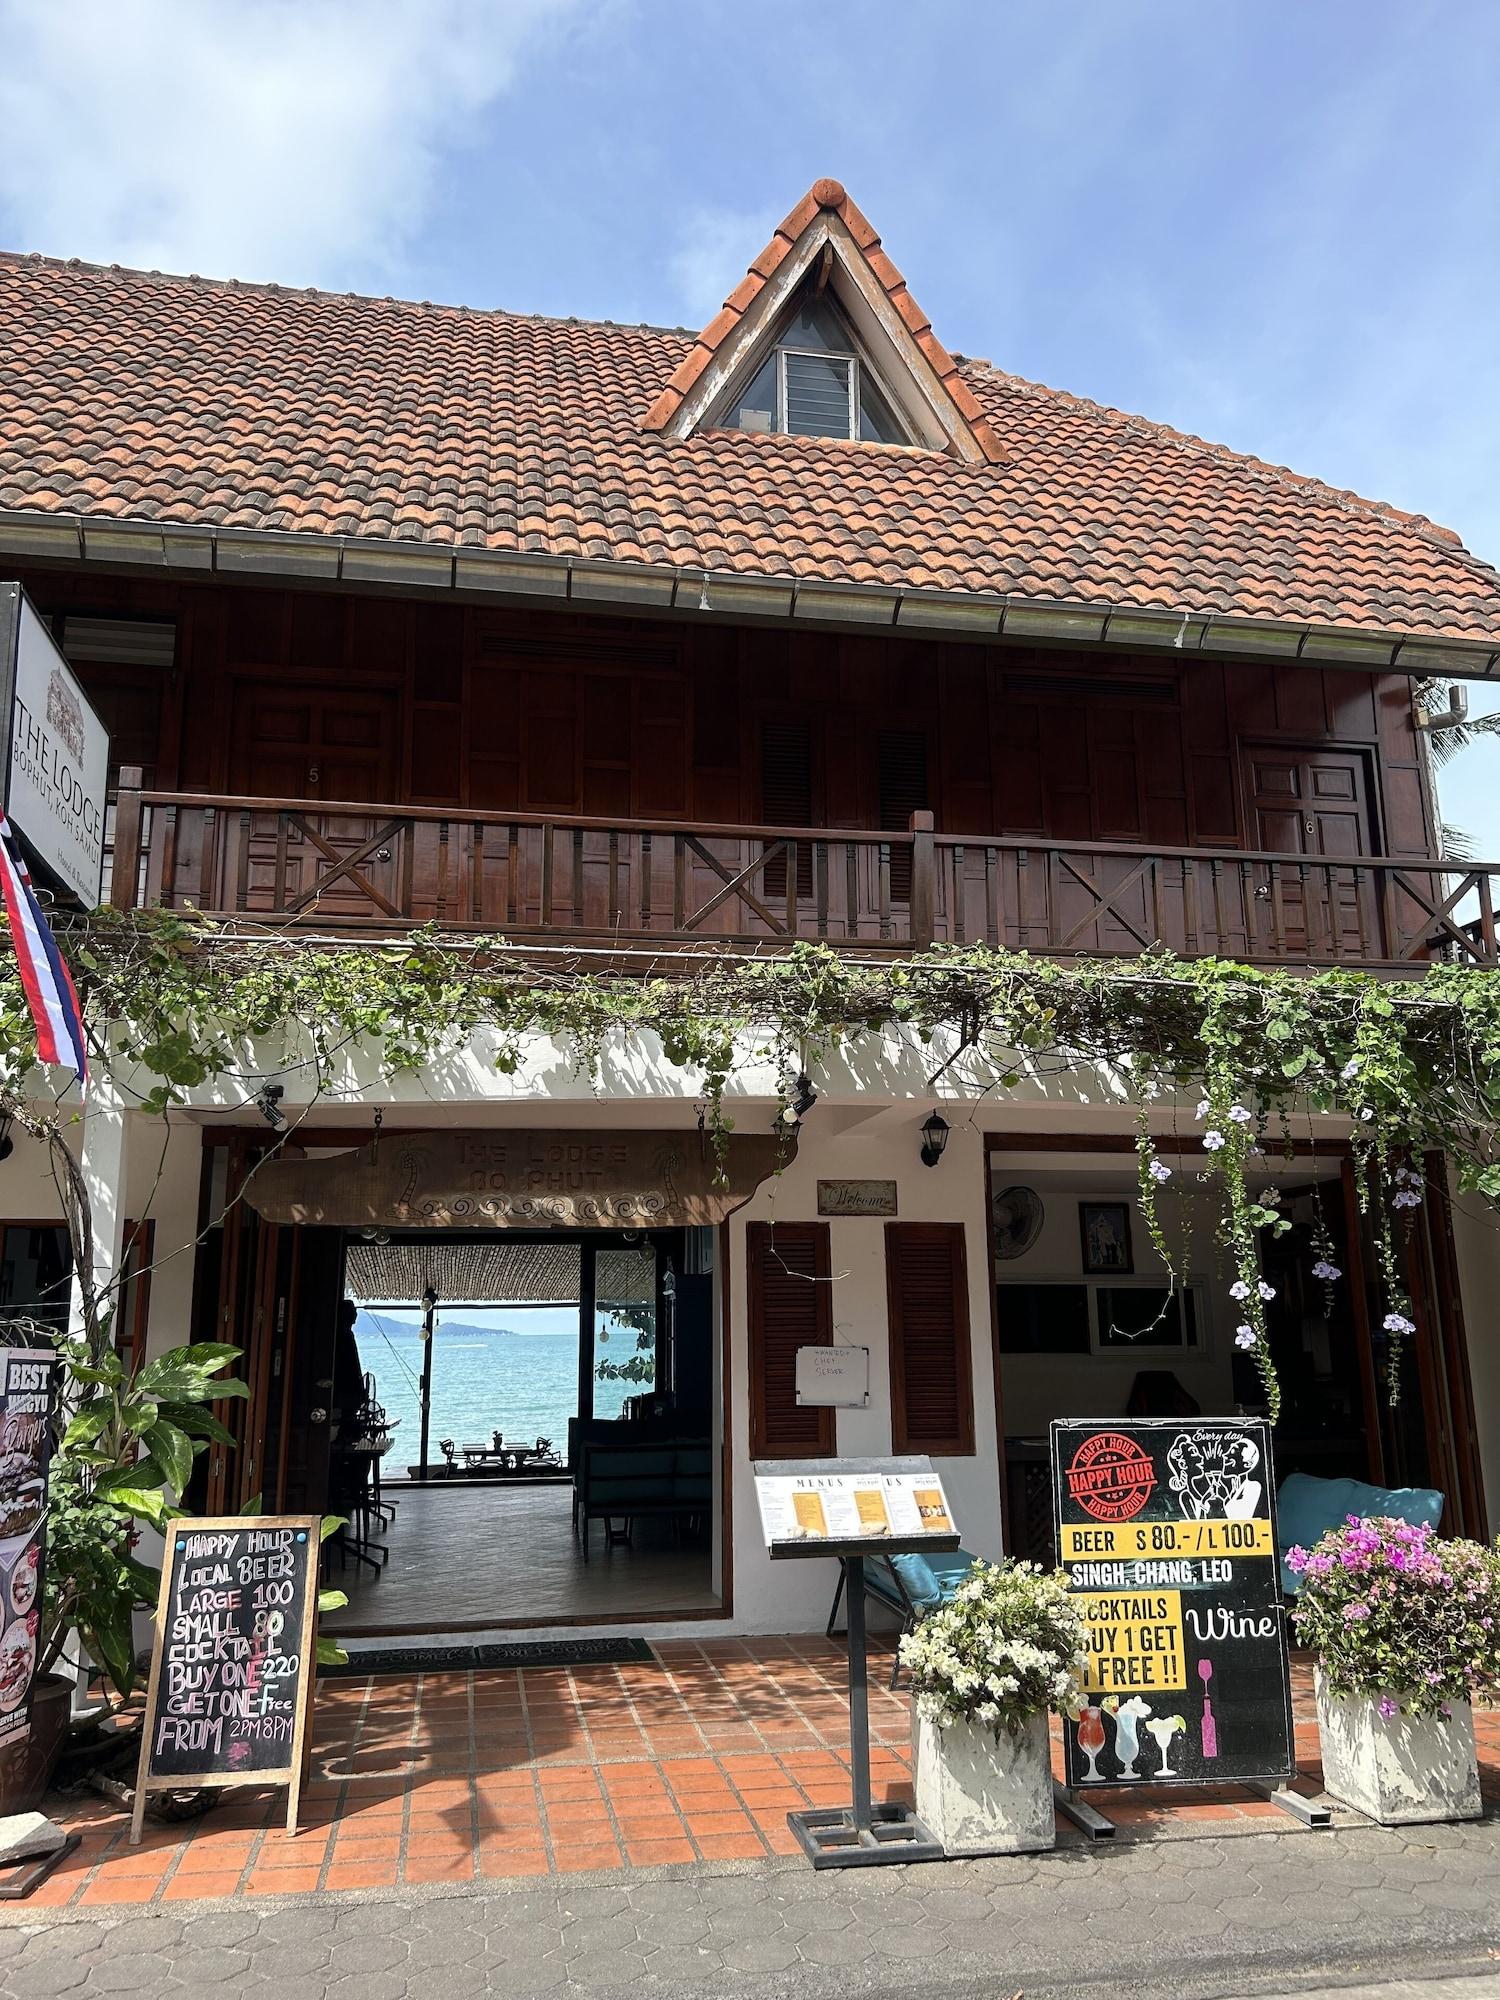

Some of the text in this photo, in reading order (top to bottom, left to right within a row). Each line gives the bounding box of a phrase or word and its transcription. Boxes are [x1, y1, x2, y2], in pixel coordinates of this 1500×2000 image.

[16, 694, 101, 845] THE LODGE
[309, 767, 319, 783] 5
[14, 740, 99, 869] BOPHUT, KOH SAMUI
[1306, 821, 1315, 834] 6
[469, 1170, 603, 1191] BO PHUT
[8, 1363, 51, 1391] BEST
[1078, 1436, 1137, 1464] HAPPY HOUR
[1192, 1429, 1244, 1442] Every day
[796, 1478, 844, 1488] MENUS
[1068, 1464, 1155, 1493] HAPPY HOUR
[1088, 1491, 1145, 1518] HAPPY HOUR
[185, 1529, 295, 1562] HAPPY HOUR
[1072, 1530, 1115, 1553] BEER
[1136, 1529, 1147, 1551] S
[1208, 1528, 1218, 1549] L
[177, 1551, 297, 1593] LOCAL BEER
[1071, 1559, 1233, 1588] SINGH, CHANG, LEO
[176, 1579, 295, 1617] LARGE 100
[172, 1610, 285, 1643] SMALL 80
[1124, 1626, 1133, 1652] 1
[1139, 1625, 1178, 1652] GET
[1185, 1606, 1278, 1642] Wine
[168, 1635, 283, 1664] COCKTAIL
[168, 1661, 219, 1696] BUY
[221, 1658, 263, 1688] ONE
[1097, 1655, 1155, 1686] FREE
[167, 1691, 220, 1716] GET
[220, 1688, 260, 1718] ONE
[156, 1715, 295, 1756] FROM 2PM 8PM
